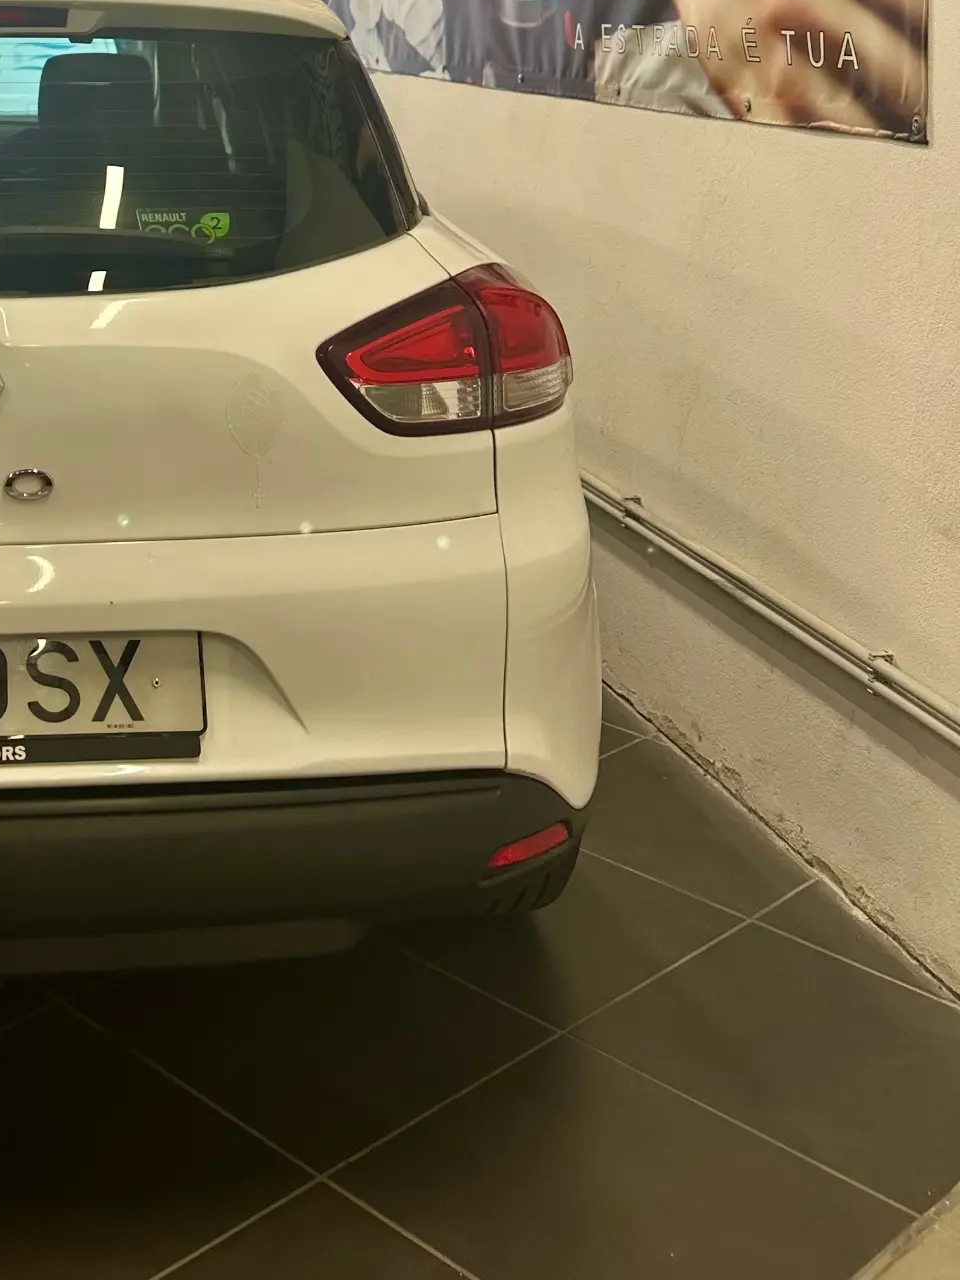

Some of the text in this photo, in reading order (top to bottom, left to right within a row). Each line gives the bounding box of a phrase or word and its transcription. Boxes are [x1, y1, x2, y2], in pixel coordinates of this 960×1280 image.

[573, 17, 859, 70] A ESTRADA É TUA
[141, 213, 187, 222] RENAULT
